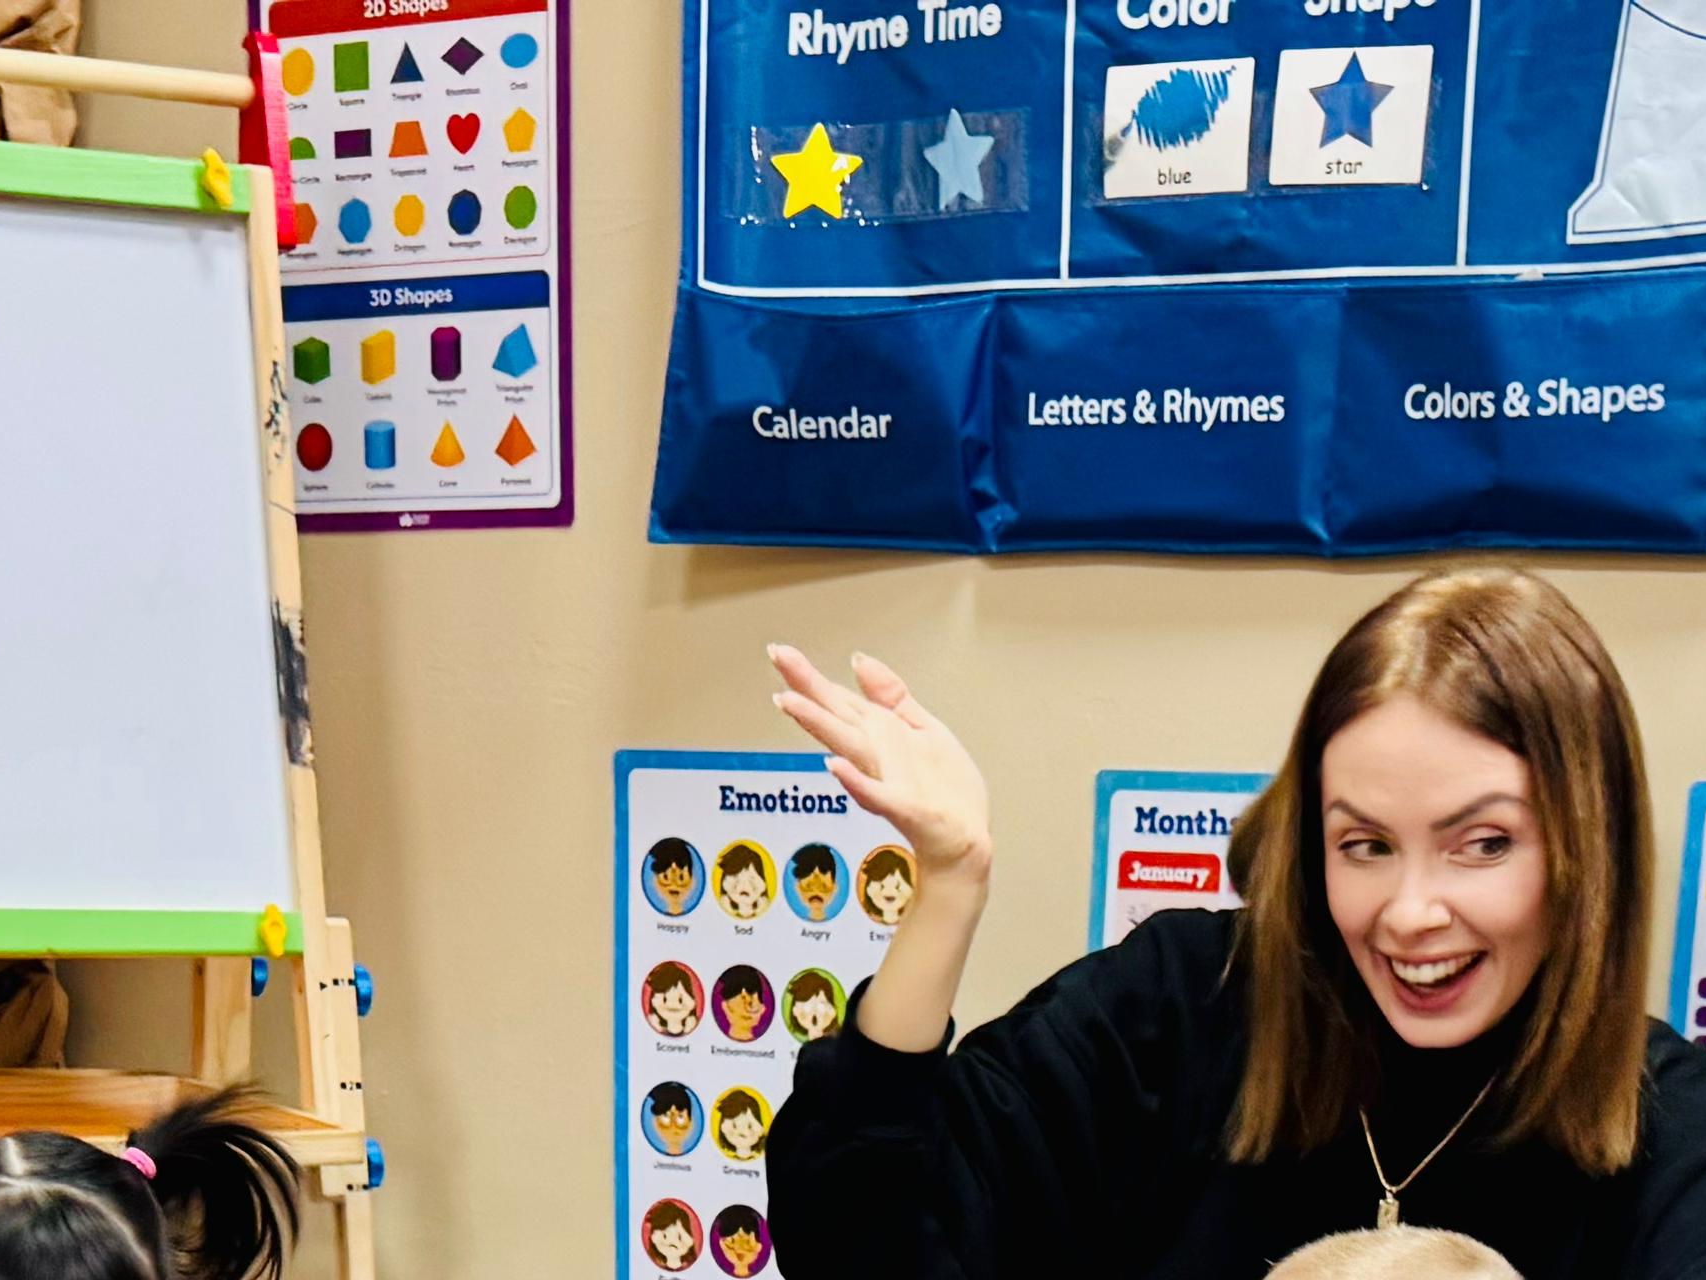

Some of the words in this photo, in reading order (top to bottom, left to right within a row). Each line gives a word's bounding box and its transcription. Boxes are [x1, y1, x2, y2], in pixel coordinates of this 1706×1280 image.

[364, 0, 386, 17] 2D
[389, 0, 449, 16] Shapes
[1117, 0, 1230, 29] Color
[788, 9, 909, 65] Rhyme
[917, 0, 1002, 43] Time
[1157, 168, 1192, 185] blue
[1325, 159, 1363, 175] star
[370, 289, 391, 307] 3D
[394, 286, 453, 307] Shapes
[1028, 391, 1126, 426] Letters
[1133, 389, 1157, 424] &
[1163, 388, 1285, 432] Rhymes
[1403, 383, 1495, 420] Colors
[1502, 381, 1531, 417] &
[1537, 377, 1665, 422] Shapes
[752, 405, 892, 440] Calendar
[719, 785, 848, 814] Emotions
[1128, 860, 1210, 889] January
[656, 922, 690, 935] Happy
[734, 925, 753, 936] Sad
[800, 928, 831, 941] Angry
[656, 1043, 690, 1054] Scared
